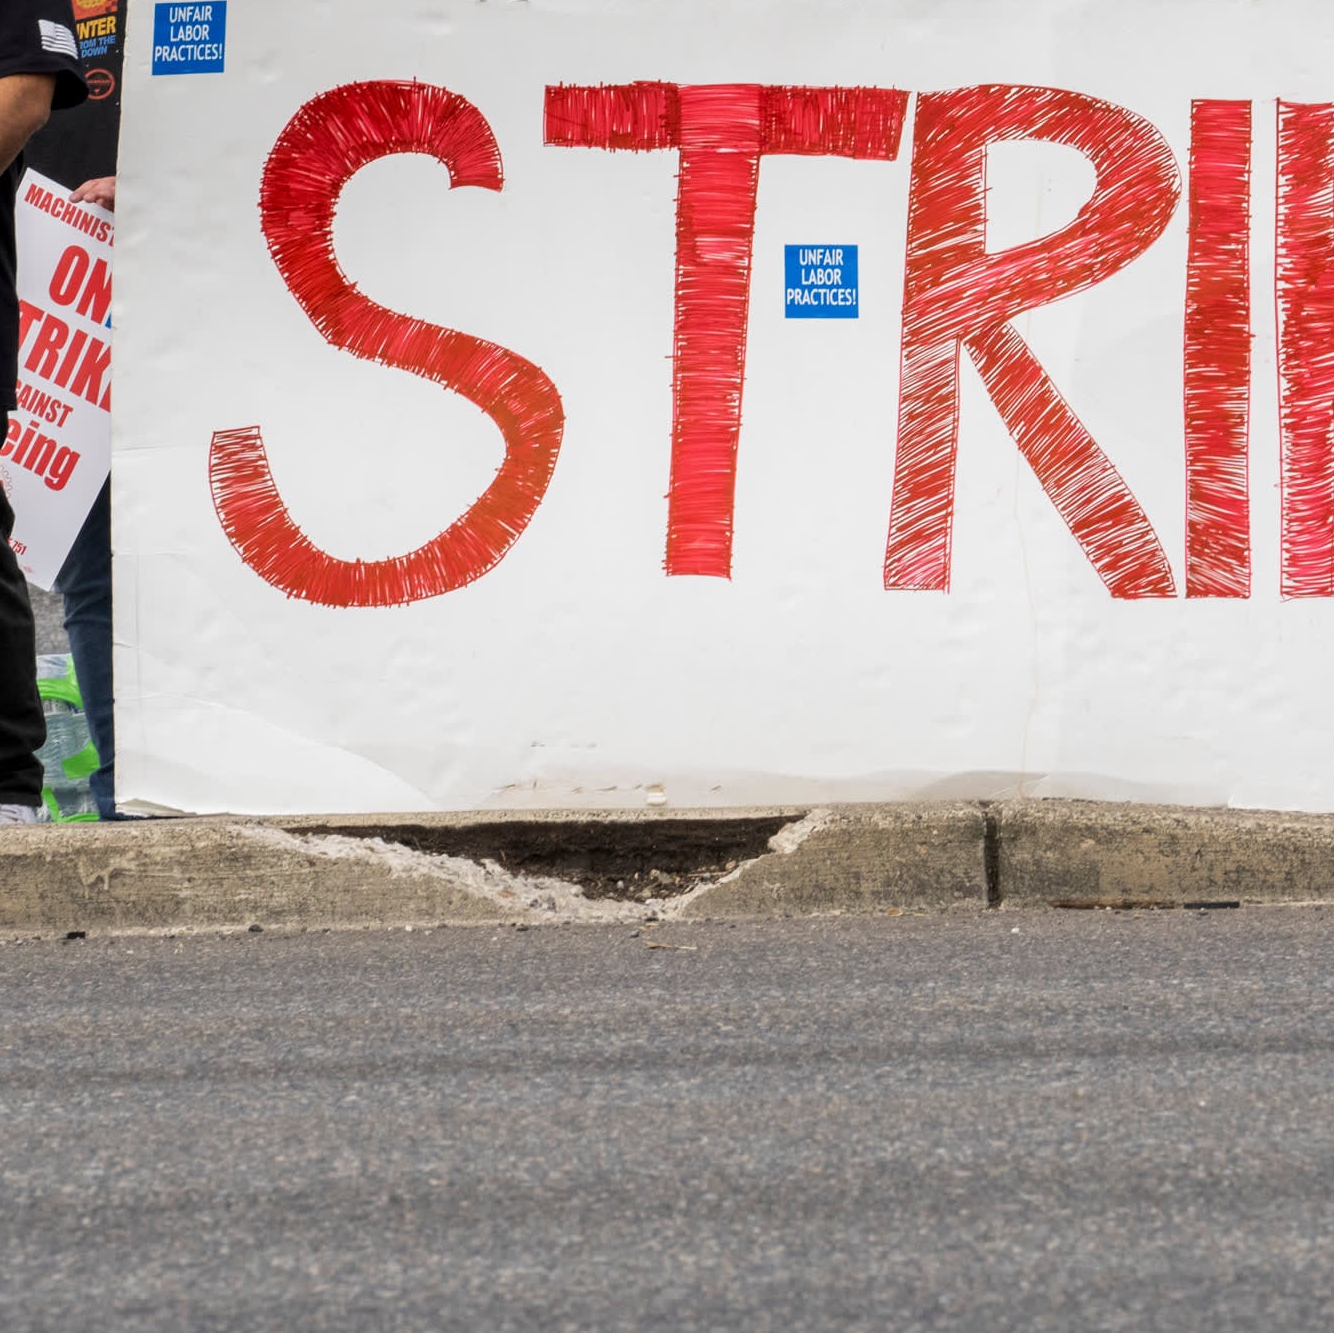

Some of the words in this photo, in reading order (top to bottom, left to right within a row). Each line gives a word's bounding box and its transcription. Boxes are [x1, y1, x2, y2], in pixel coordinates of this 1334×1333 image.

[170, 6, 212, 22] UNFAIR
[171, 25, 209, 41] LABOR
[155, 44, 222, 61] PRACTICES!
[800, 249, 843, 265] UNFAIR
[49, 245, 111, 325] ON
[802, 269, 841, 285] LABOR
[787, 289, 857, 306] PRACTICES!
